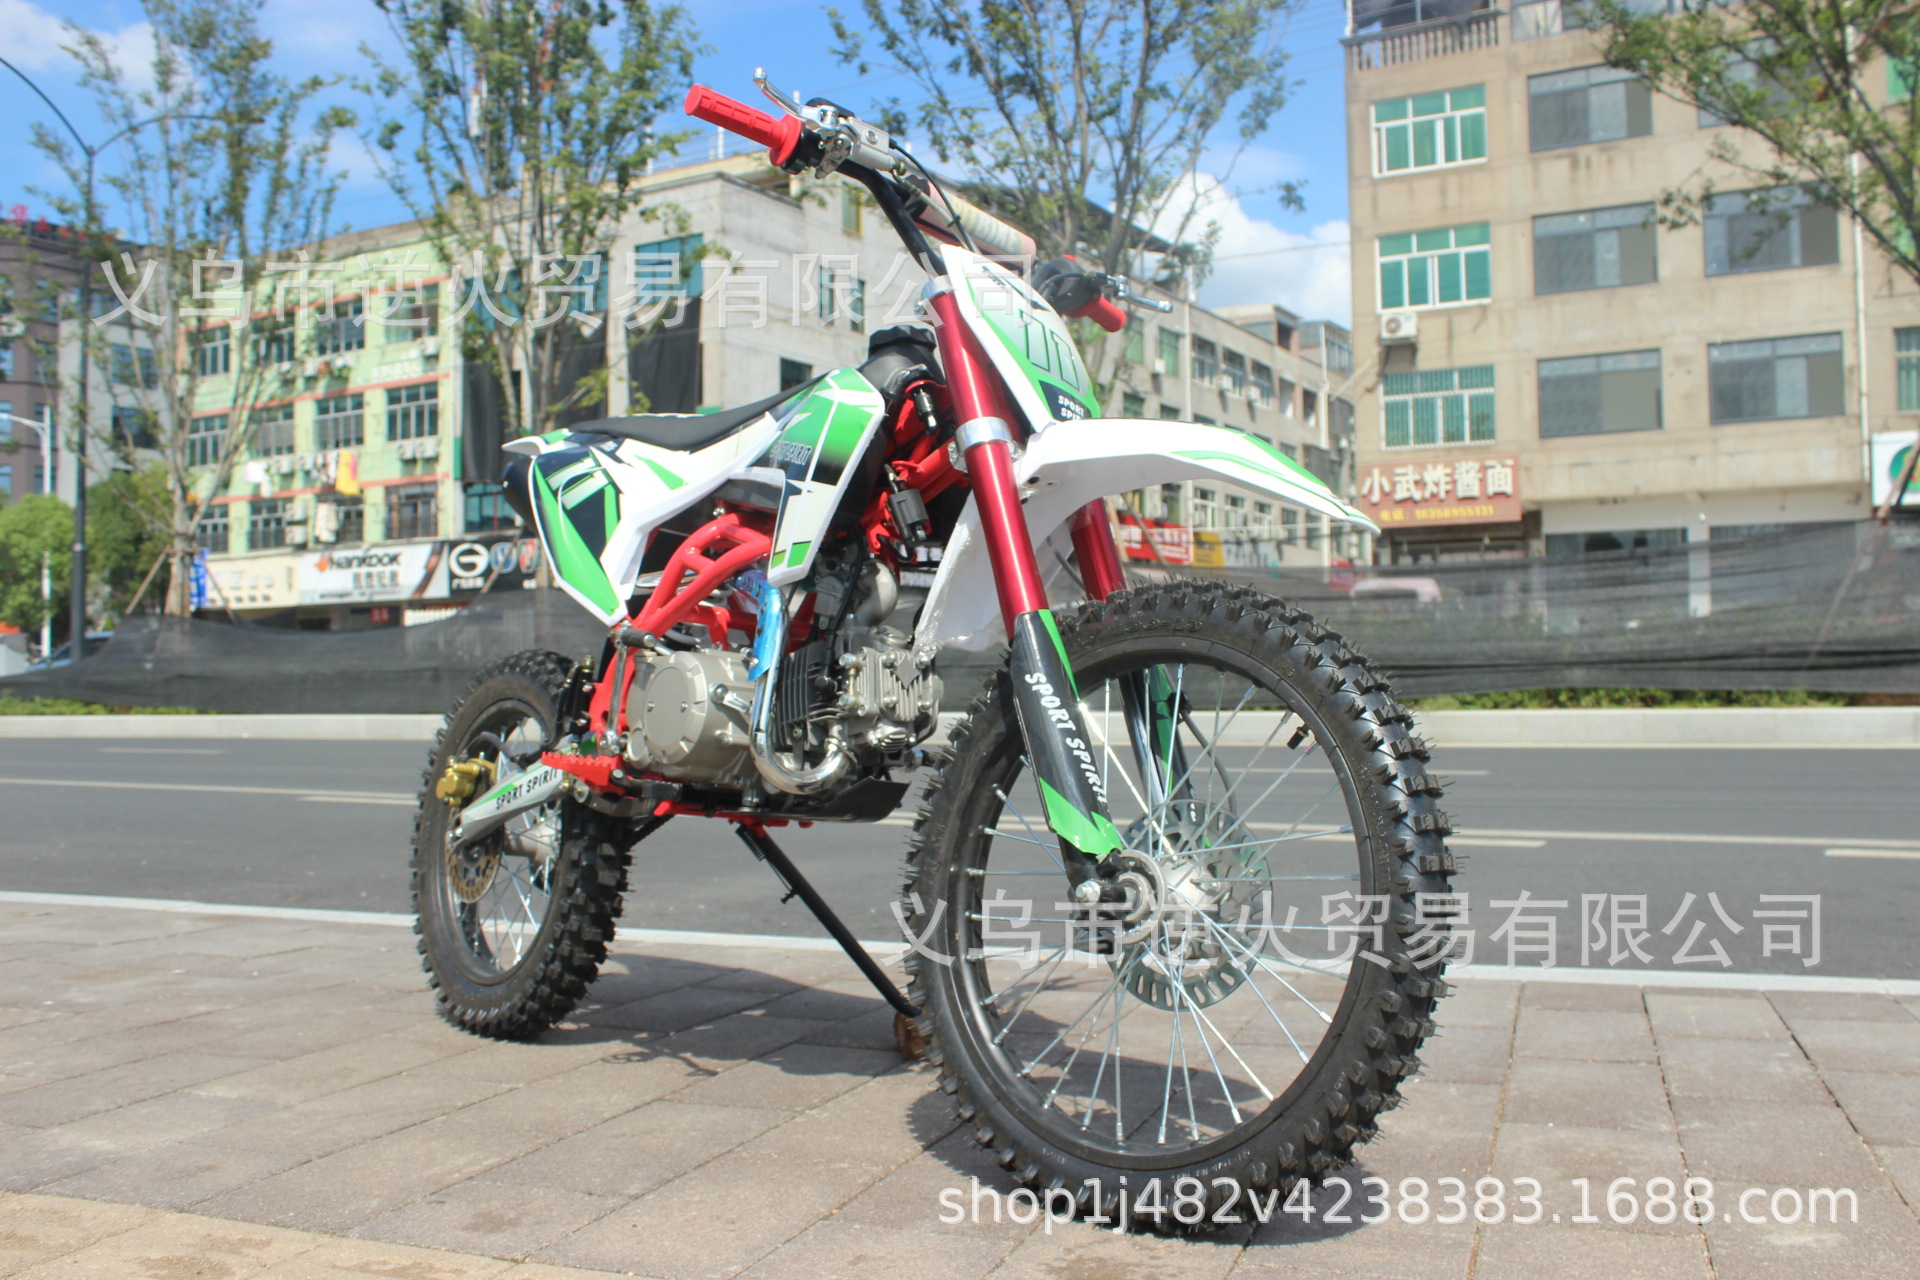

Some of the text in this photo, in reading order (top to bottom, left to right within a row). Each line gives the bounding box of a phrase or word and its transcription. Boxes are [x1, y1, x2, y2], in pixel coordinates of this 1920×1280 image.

[1057, 394, 1084, 417] SPORT
[1361, 459, 1515, 505] 小武炸酱面
[1025, 672, 1076, 731] SPORT
[496, 784, 524, 810] SPORT
